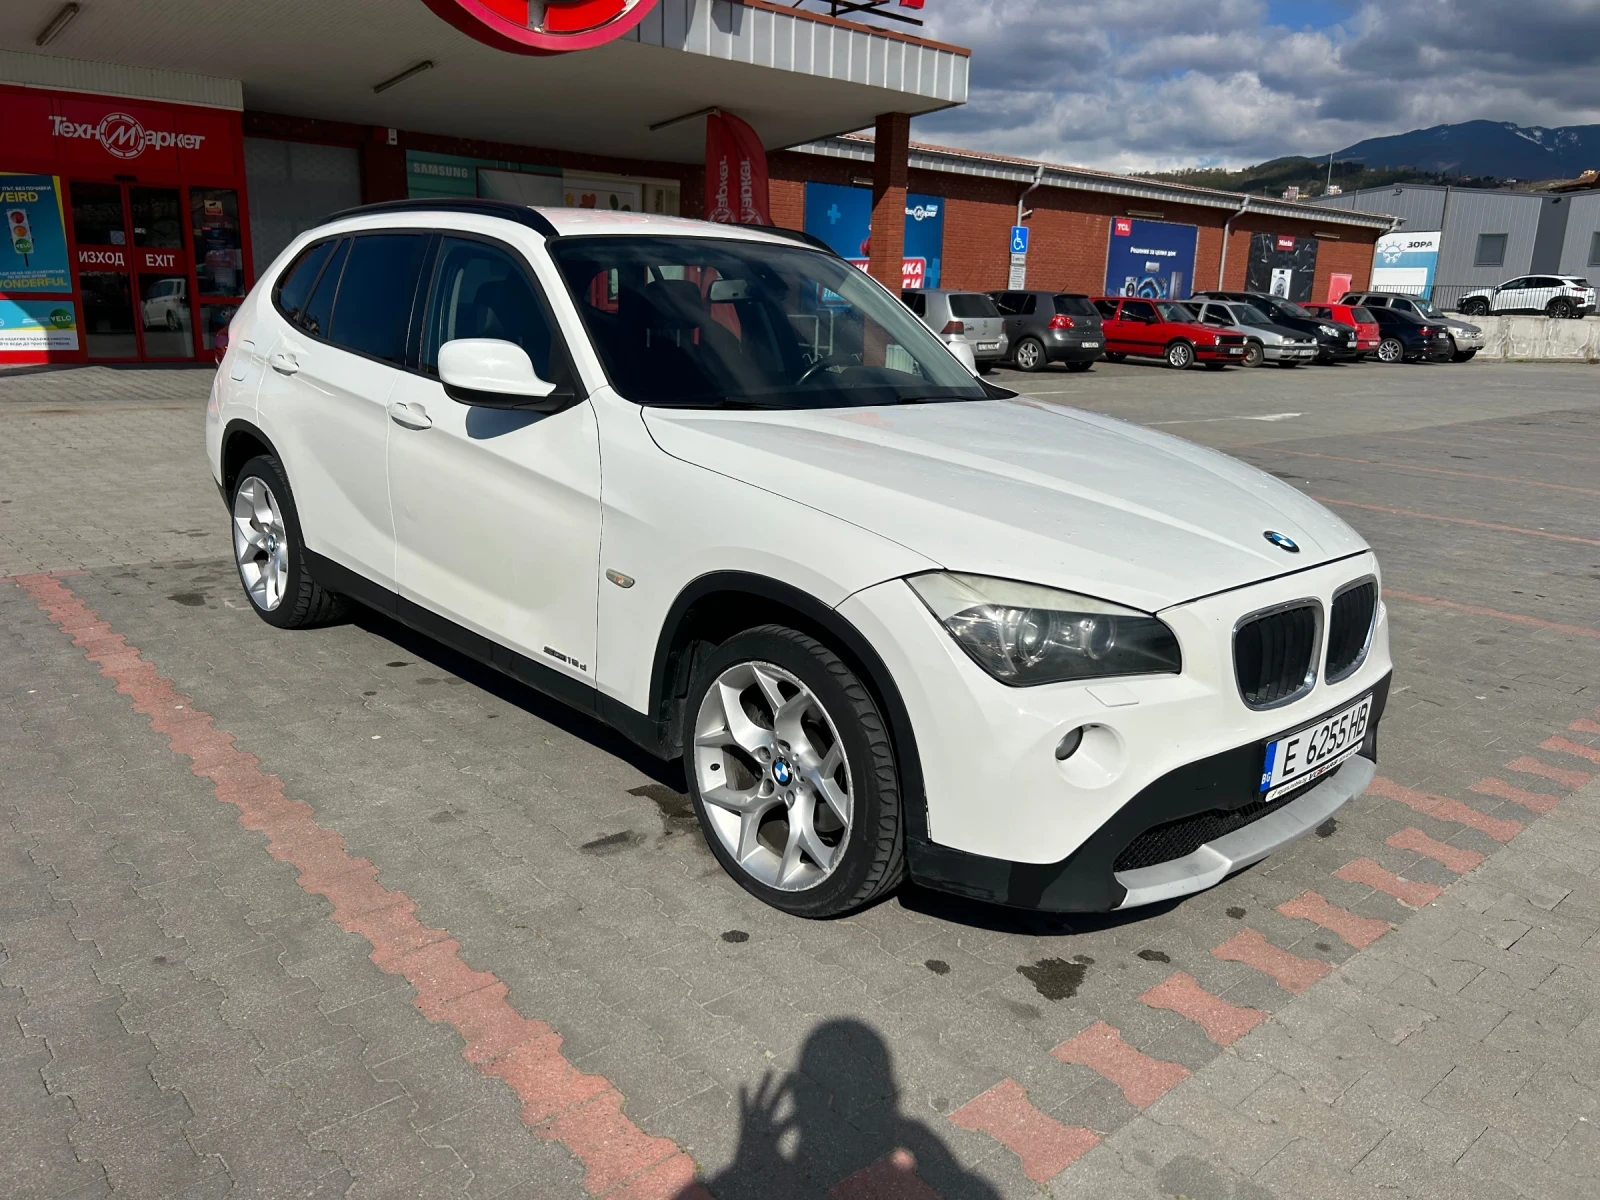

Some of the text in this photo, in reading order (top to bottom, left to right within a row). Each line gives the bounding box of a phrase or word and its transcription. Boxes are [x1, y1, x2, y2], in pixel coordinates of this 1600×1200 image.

[413, 162, 468, 178] SAMSUNG
[1117, 223, 1129, 231] TCL
[1278, 239, 1292, 247] Miele
[79, 251, 125, 266] ИЗХОД
[145, 254, 175, 267] EXIT
[51, 314, 71, 322] VELO
[1282, 738, 1300, 777] E
[1306, 714, 1348, 764] 6255
[1347, 702, 1368, 743] HB
[1261, 772, 1272, 785] BG
